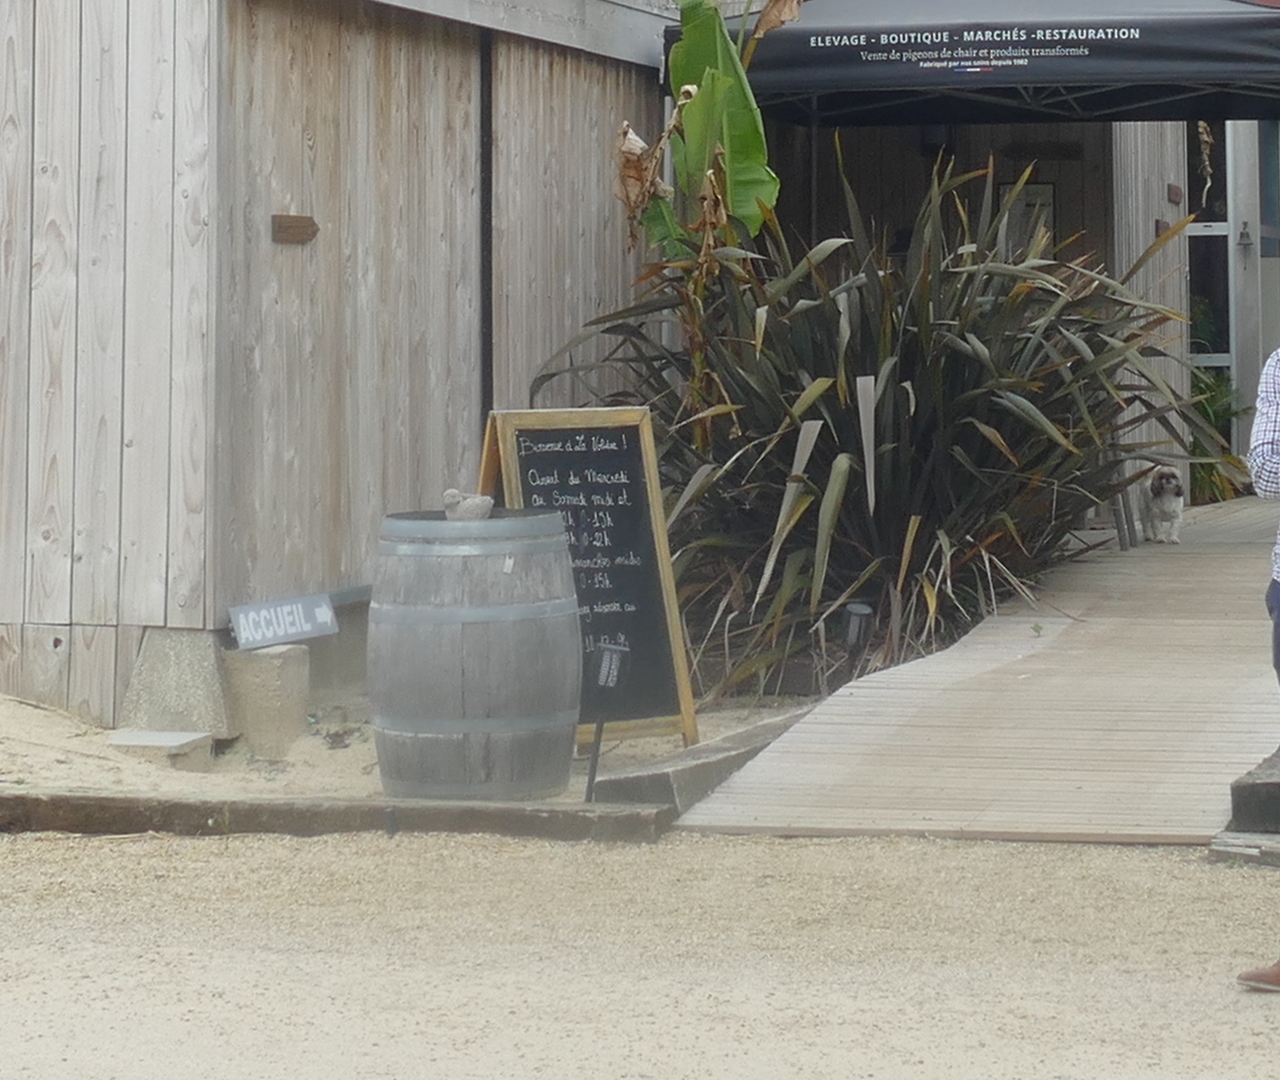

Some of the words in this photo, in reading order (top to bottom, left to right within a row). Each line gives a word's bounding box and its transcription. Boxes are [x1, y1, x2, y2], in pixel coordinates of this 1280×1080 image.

[810, 35, 867, 47] ELEVAGE
[880, 31, 949, 45] BOUTIQUE
[963, 27, 1027, 41] MARCHÉS
[860, 51, 888, 60] Vente
[889, 49, 901, 60] de
[902, 49, 939, 62] pigeons
[940, 47, 952, 58] de
[953, 47, 977, 58] chair
[978, 48, 989, 57] et
[990, 46, 1030, 59] produits
[1031, 45, 1089, 57] transformés
[584, 469, 630, 484] Mercredi
[238, 603, 312, 643] ACCUEIL
